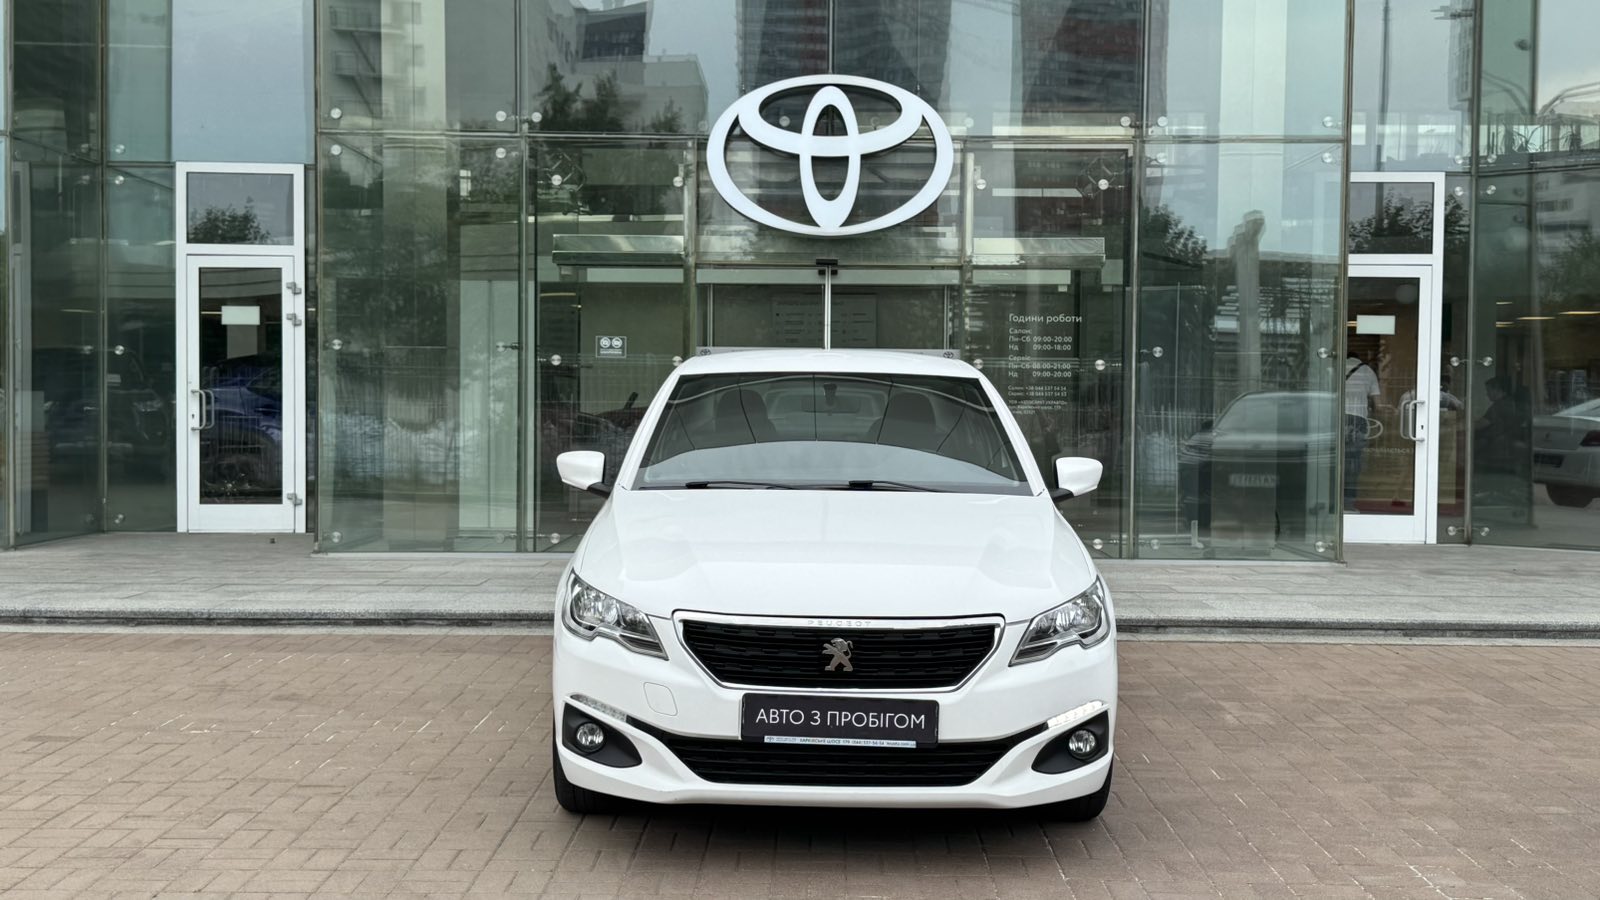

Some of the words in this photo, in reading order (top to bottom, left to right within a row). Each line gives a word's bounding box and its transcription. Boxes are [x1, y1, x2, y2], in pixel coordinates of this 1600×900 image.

[1008, 313, 1044, 323] Години
[1046, 314, 1082, 324] роботи
[755, 708, 805, 725] АВТО
[810, 710, 821, 726] З
[827, 711, 925, 729] ПРОБІГОМ
